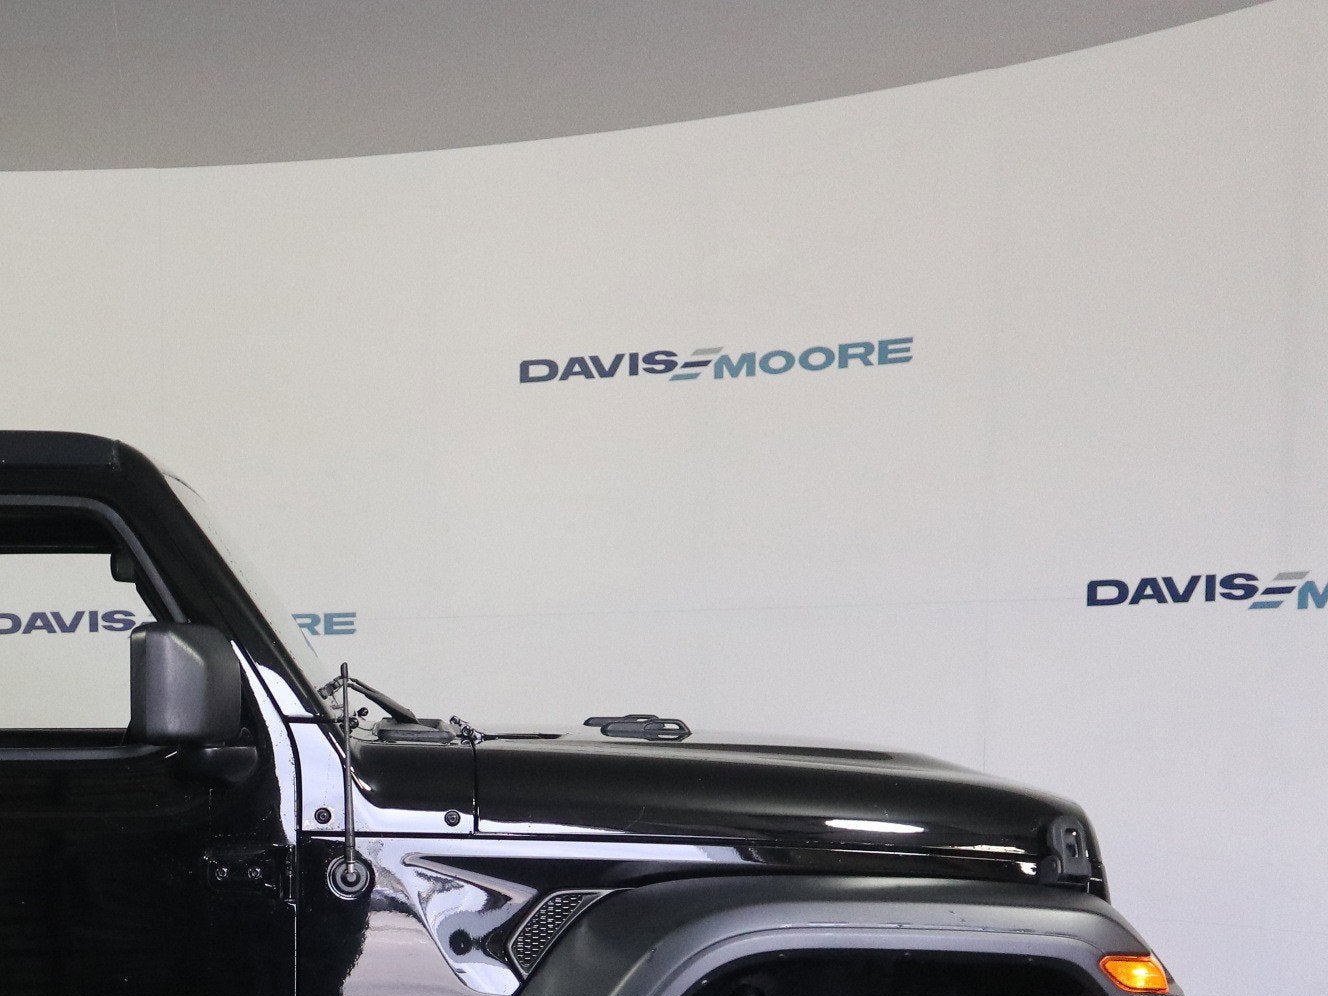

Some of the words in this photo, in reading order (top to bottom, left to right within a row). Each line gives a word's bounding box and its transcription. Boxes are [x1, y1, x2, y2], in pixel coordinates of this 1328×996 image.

[519, 350, 678, 384] DAVIS
[714, 336, 914, 380] MOORE
[1086, 572, 1260, 607] DAVIS
